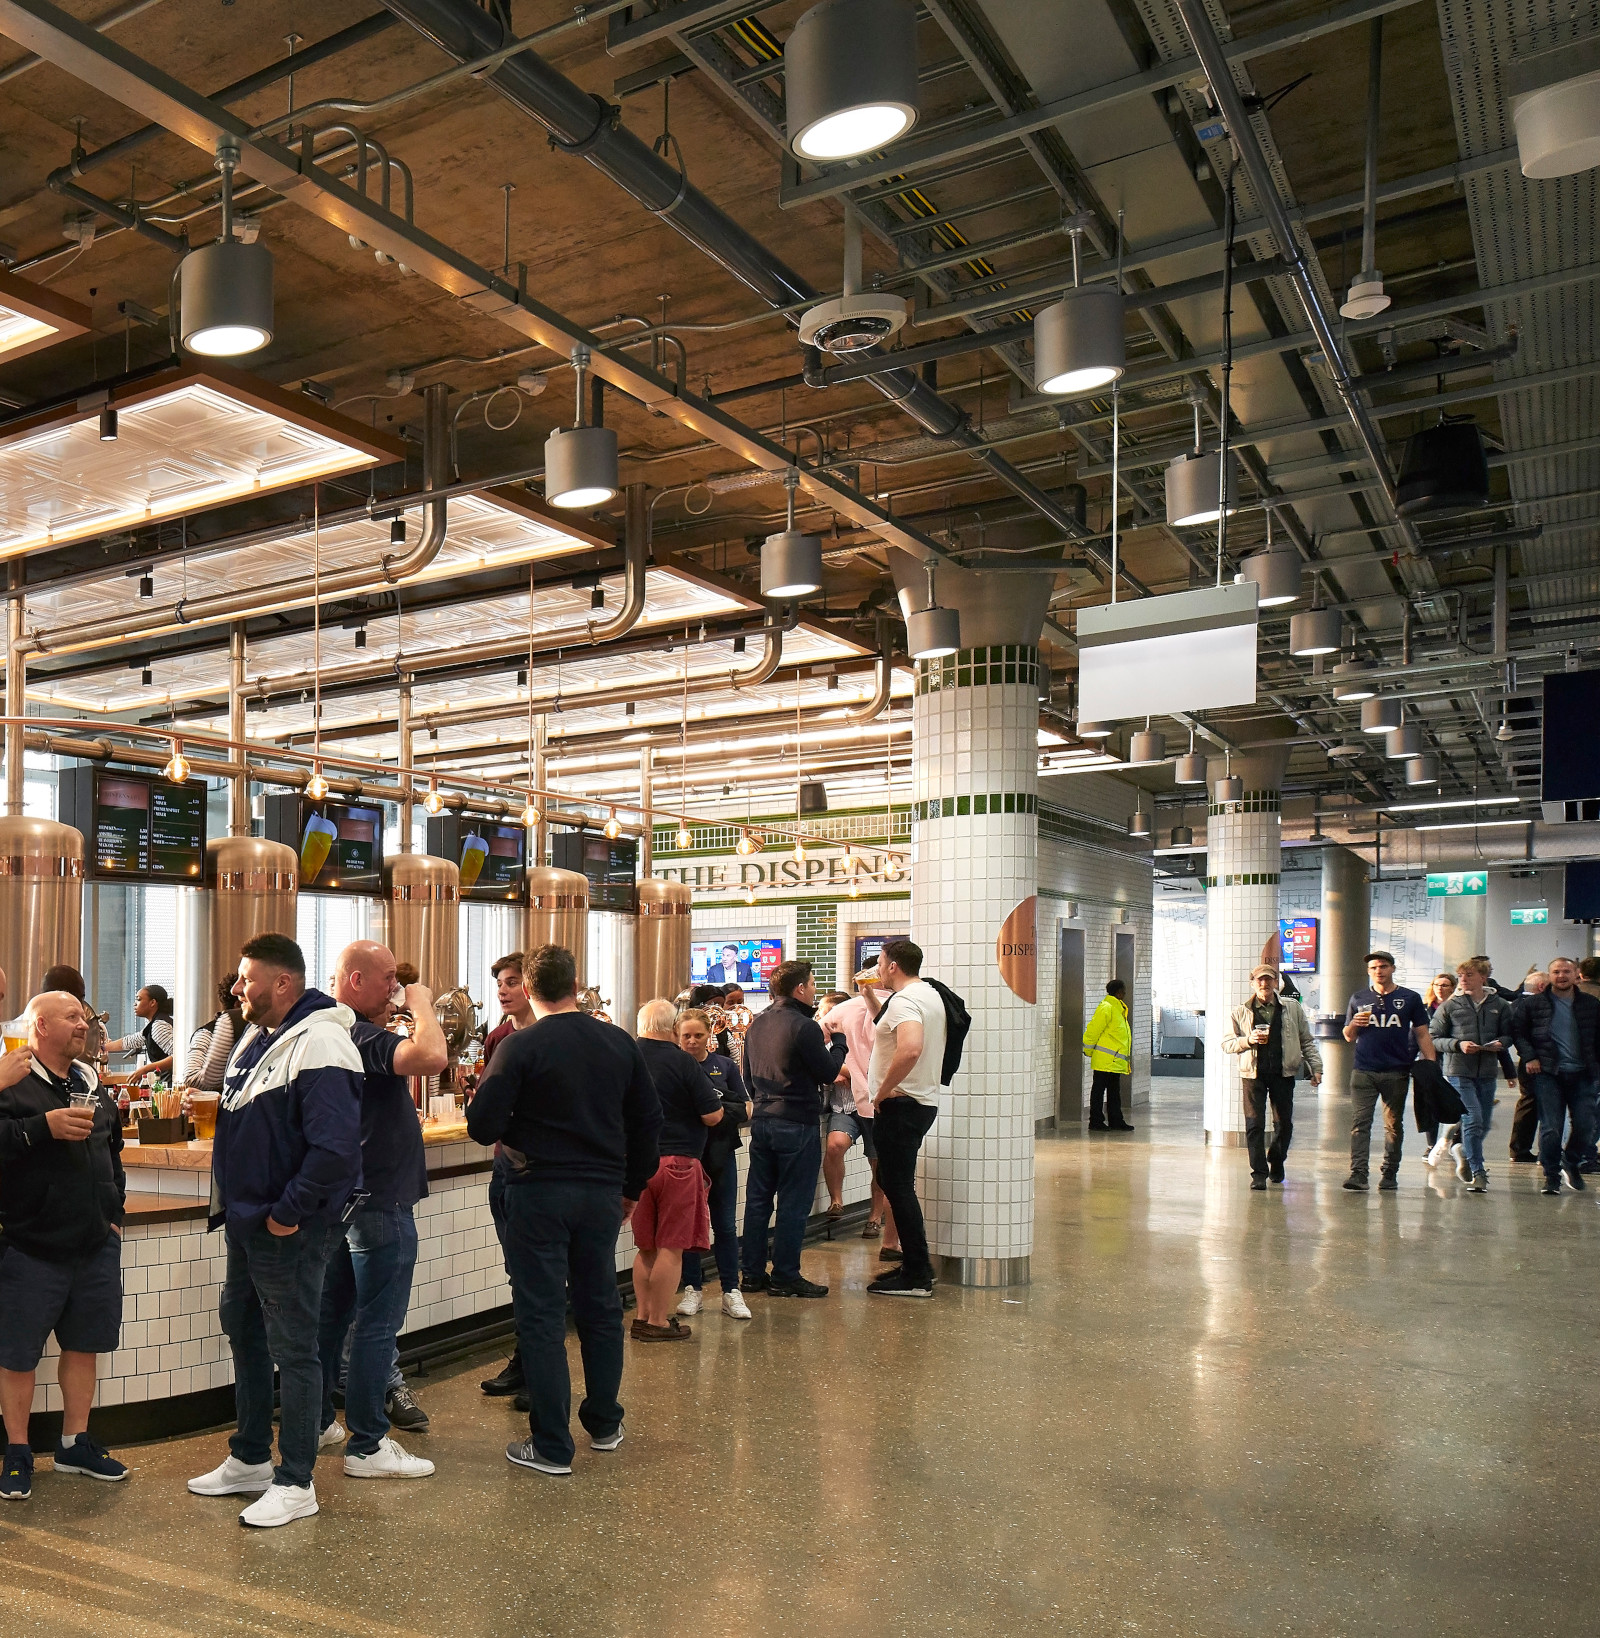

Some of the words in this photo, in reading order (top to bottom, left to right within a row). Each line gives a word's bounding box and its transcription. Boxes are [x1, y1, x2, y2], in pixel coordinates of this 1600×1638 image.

[653, 864, 728, 892] THE
[737, 854, 912, 889] DISPENS
[1369, 1013, 1402, 1028] AIA
